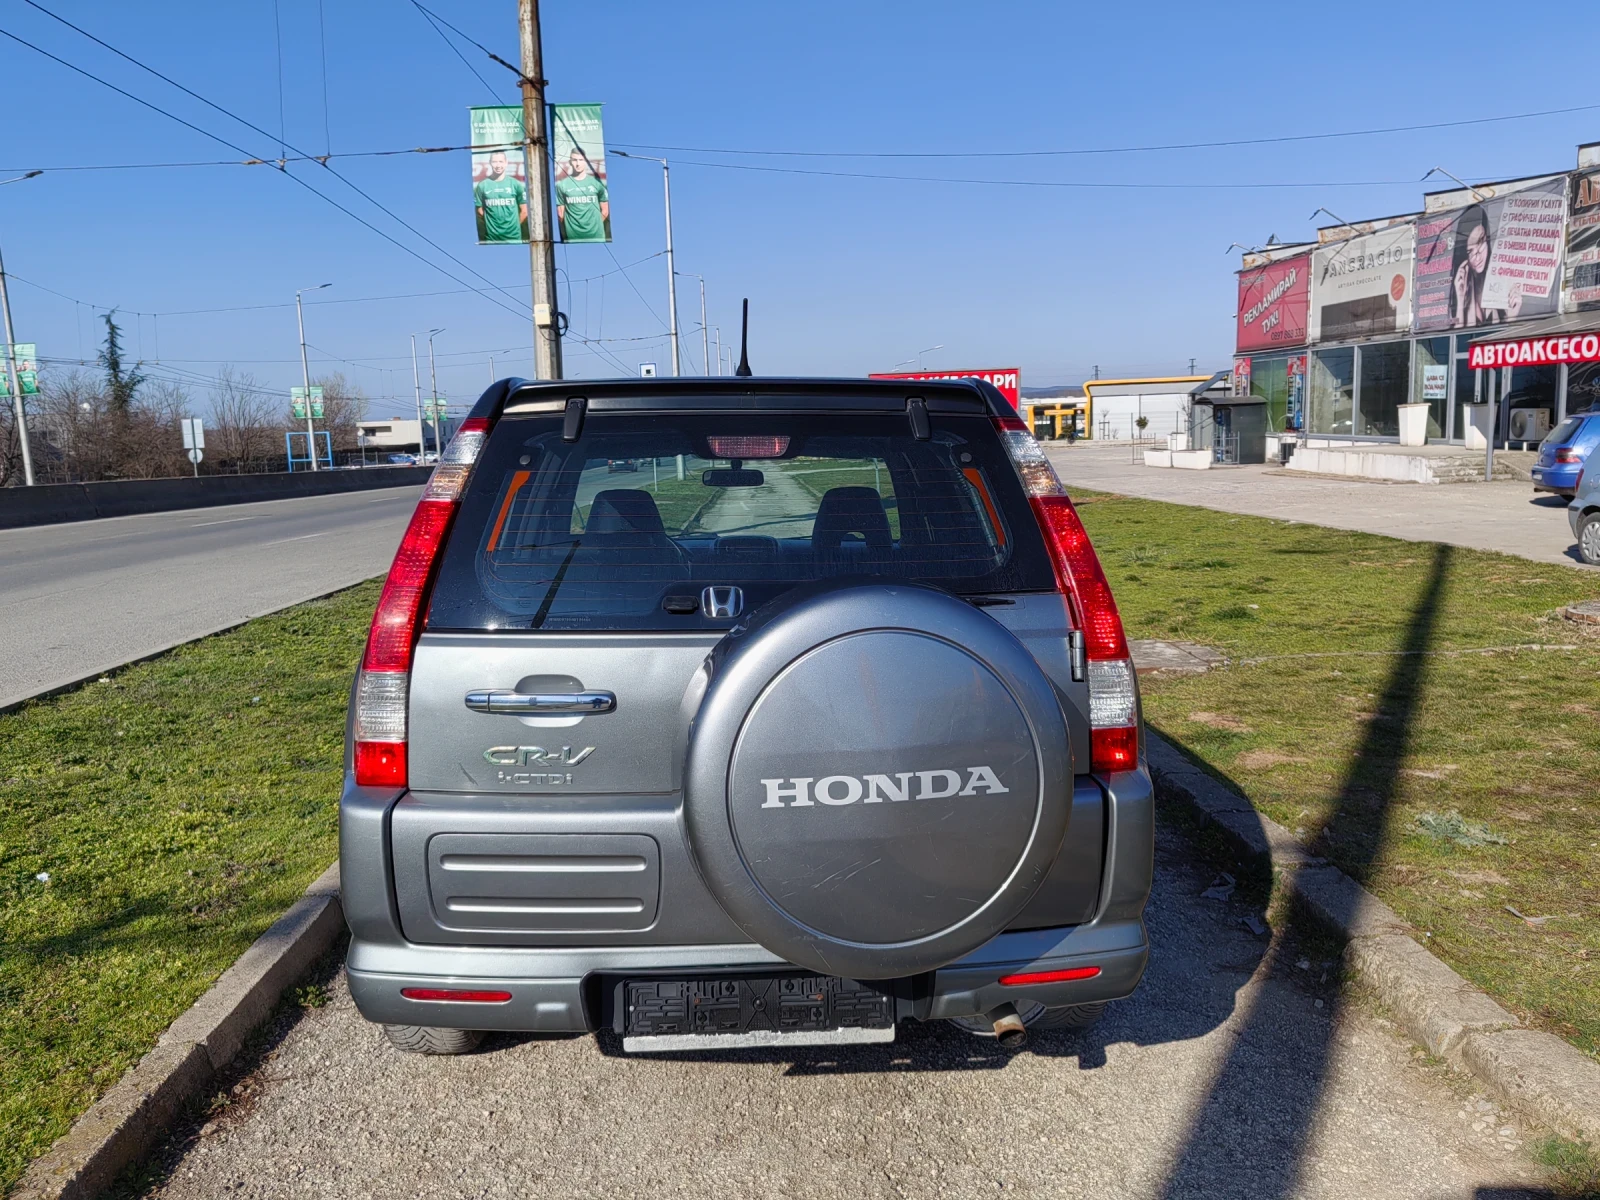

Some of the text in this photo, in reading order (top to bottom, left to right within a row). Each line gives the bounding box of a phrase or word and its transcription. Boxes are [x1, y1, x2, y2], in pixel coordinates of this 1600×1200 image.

[485, 197, 516, 207] WINBET
[565, 195, 597, 204] WINBET
[1507, 226, 1559, 239] ПЕЧАТНА РЕКЛАМА
[1528, 242, 1555, 253] РЕКЛАМА
[1498, 253, 1557, 268] РЕКЛАМНИ СУВЕНИРИ
[1356, 275, 1382, 286] CHOCOLATE
[1526, 270, 1549, 281] ПЕЧАТИ
[1522, 283, 1548, 295] ТЕНИСКИ
[1243, 266, 1297, 327] РЕКЛАМИРАЙ
[1261, 309, 1279, 334] ТУК!
[1471, 334, 1600, 367] АВТОАКСЕСО
[482, 745, 597, 767] CR-V
[498, 771, 573, 785] i-CTDi
[760, 765, 1010, 809] HONDA
